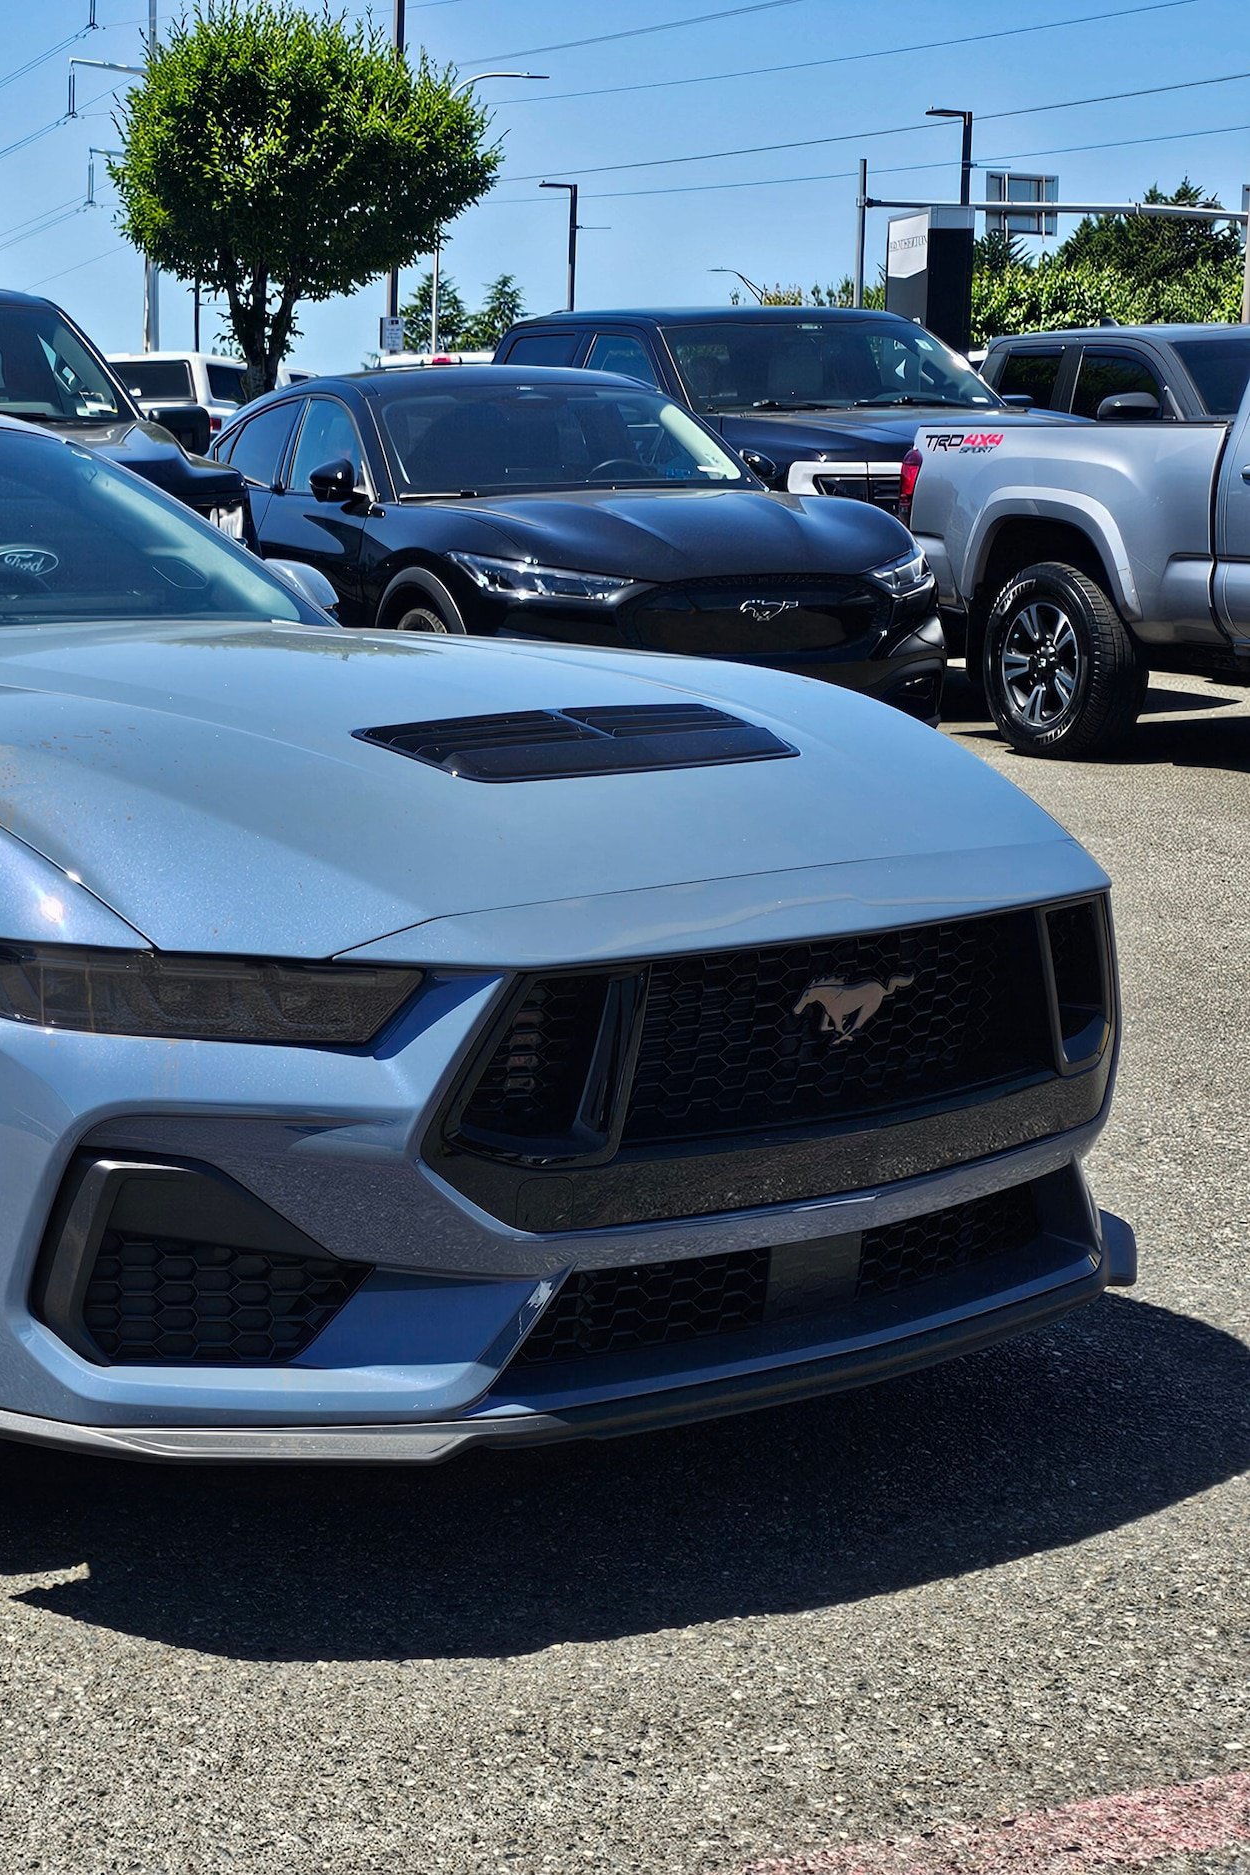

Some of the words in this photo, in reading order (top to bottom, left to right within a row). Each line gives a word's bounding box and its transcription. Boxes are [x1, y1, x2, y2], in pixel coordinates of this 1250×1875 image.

[925, 434, 965, 452] TRD
[958, 446, 998, 454] SPORT
[4, 553, 45, 573] Ford
